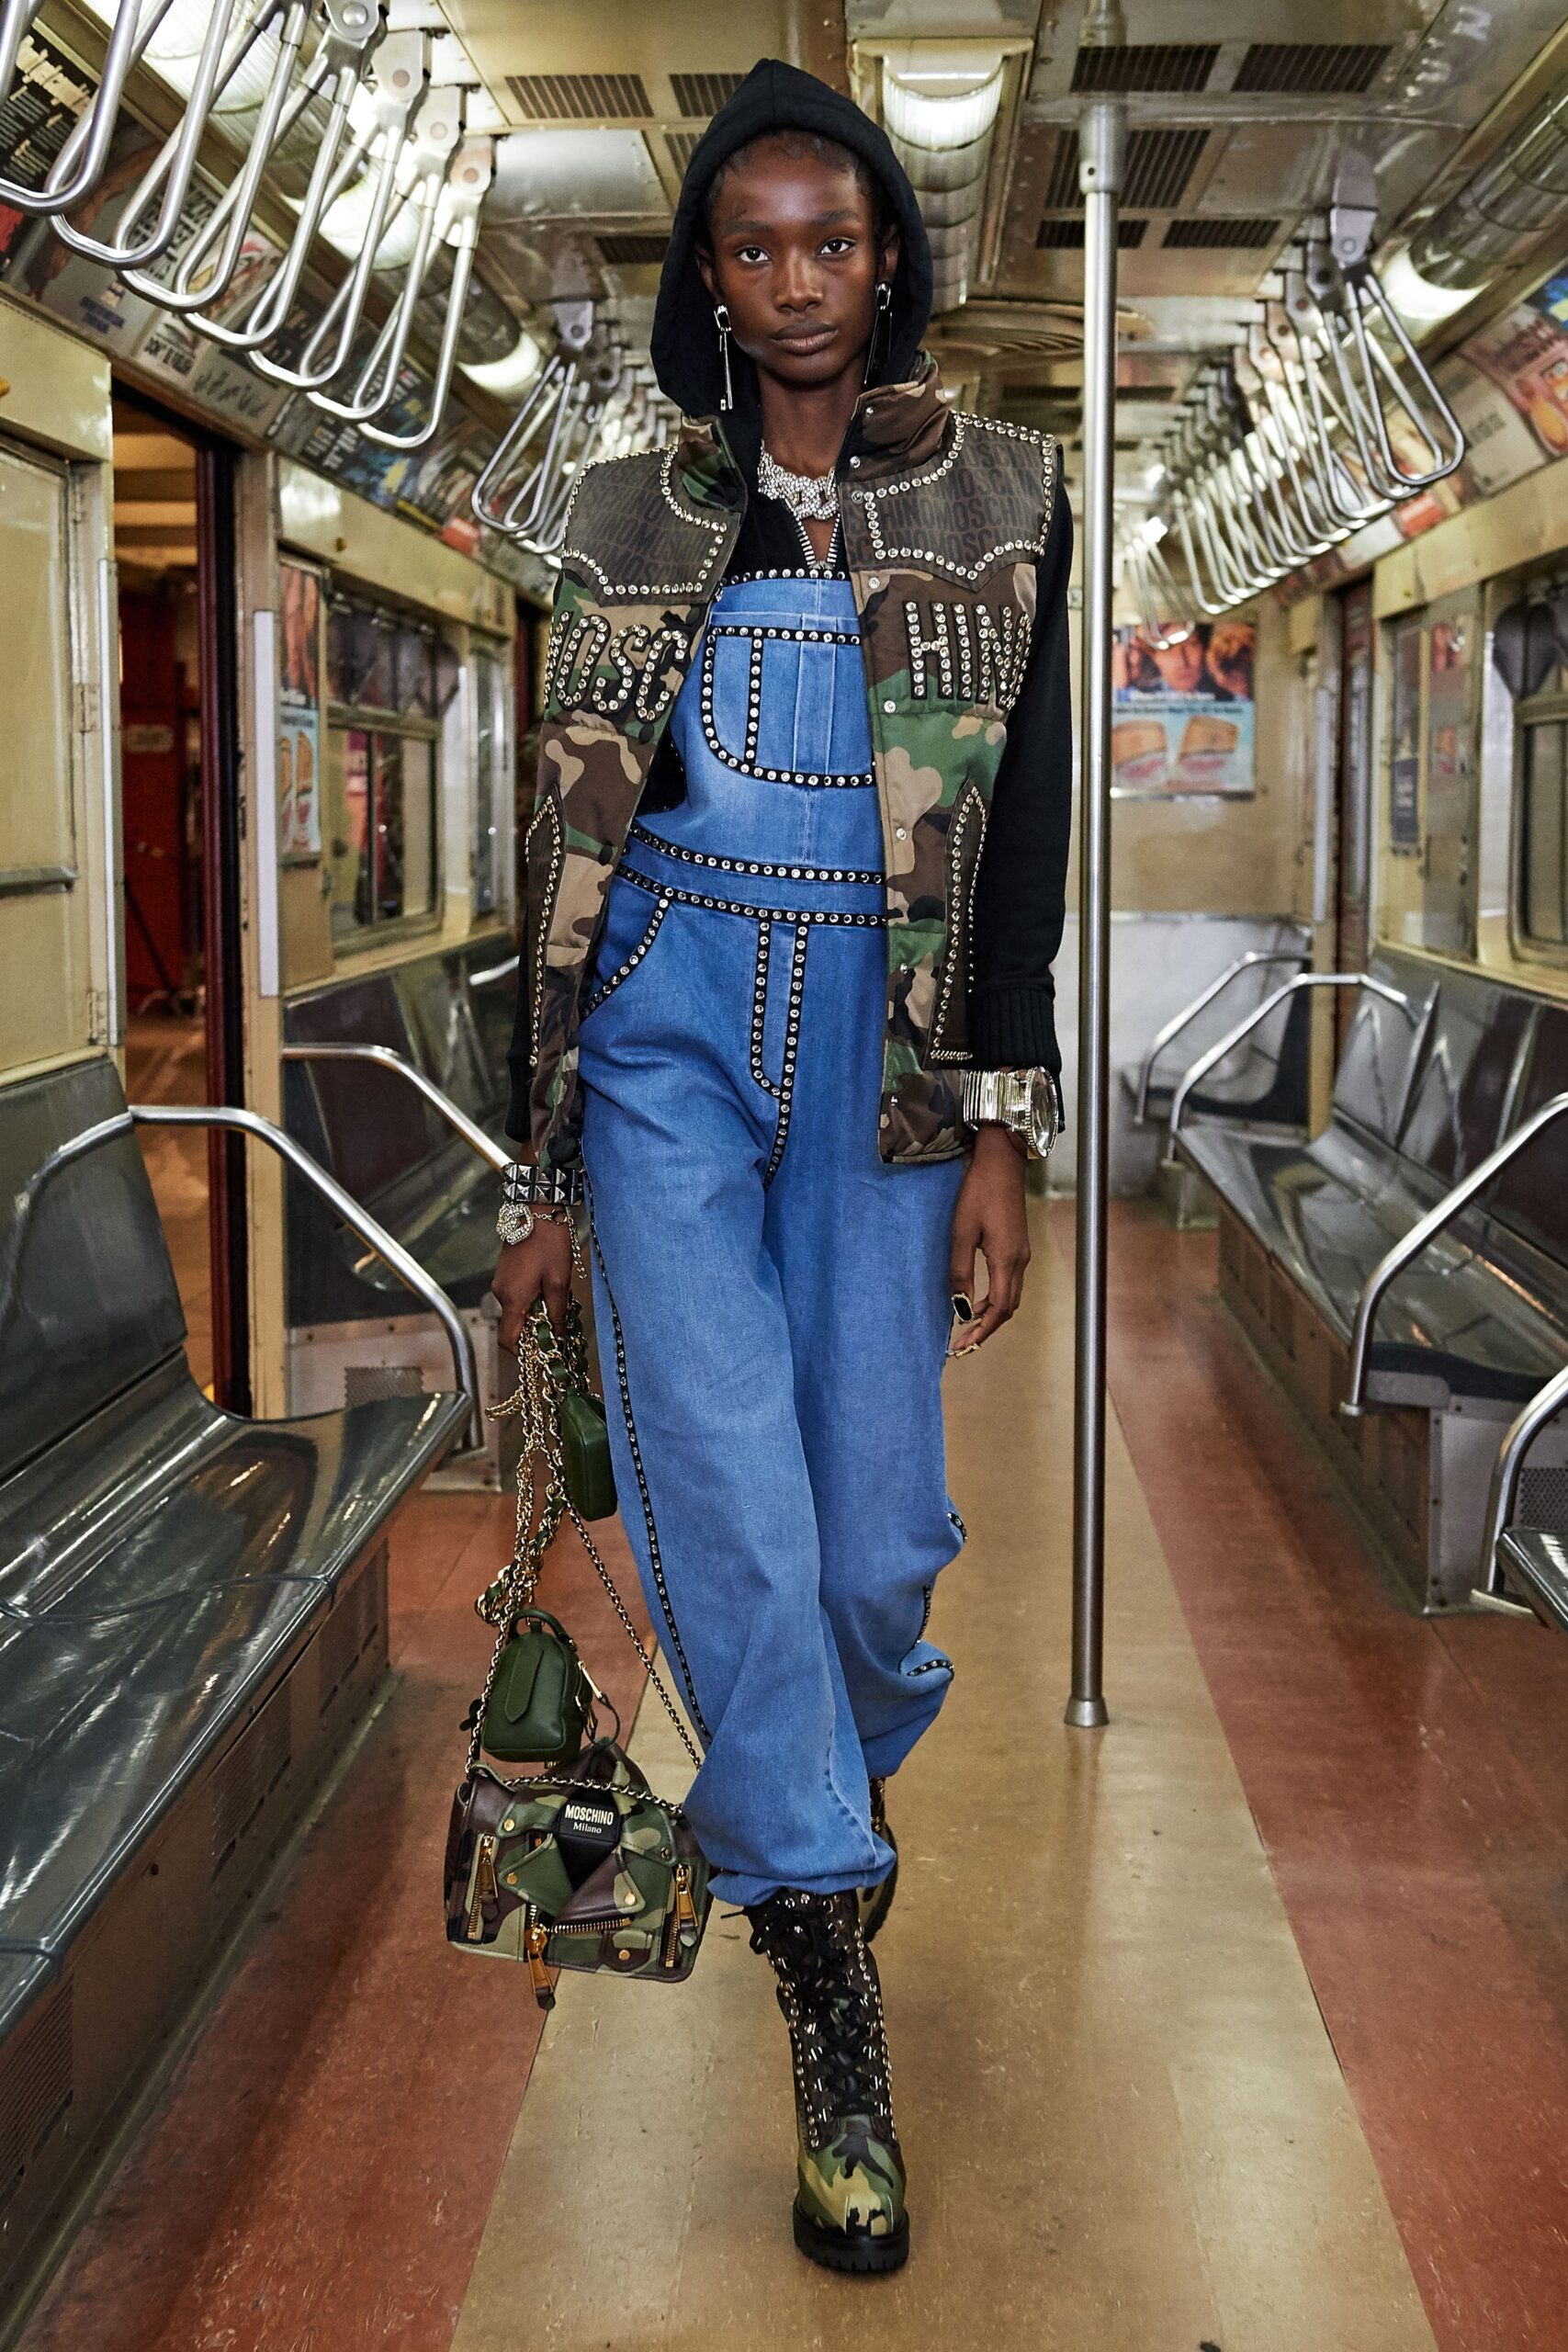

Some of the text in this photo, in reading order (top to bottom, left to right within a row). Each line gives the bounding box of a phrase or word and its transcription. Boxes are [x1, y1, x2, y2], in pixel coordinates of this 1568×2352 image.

[902, 600, 1033, 711] HINO
[565, 1804, 614, 1826] MOSCHINO
[573, 1822, 602, 1834] Milano
